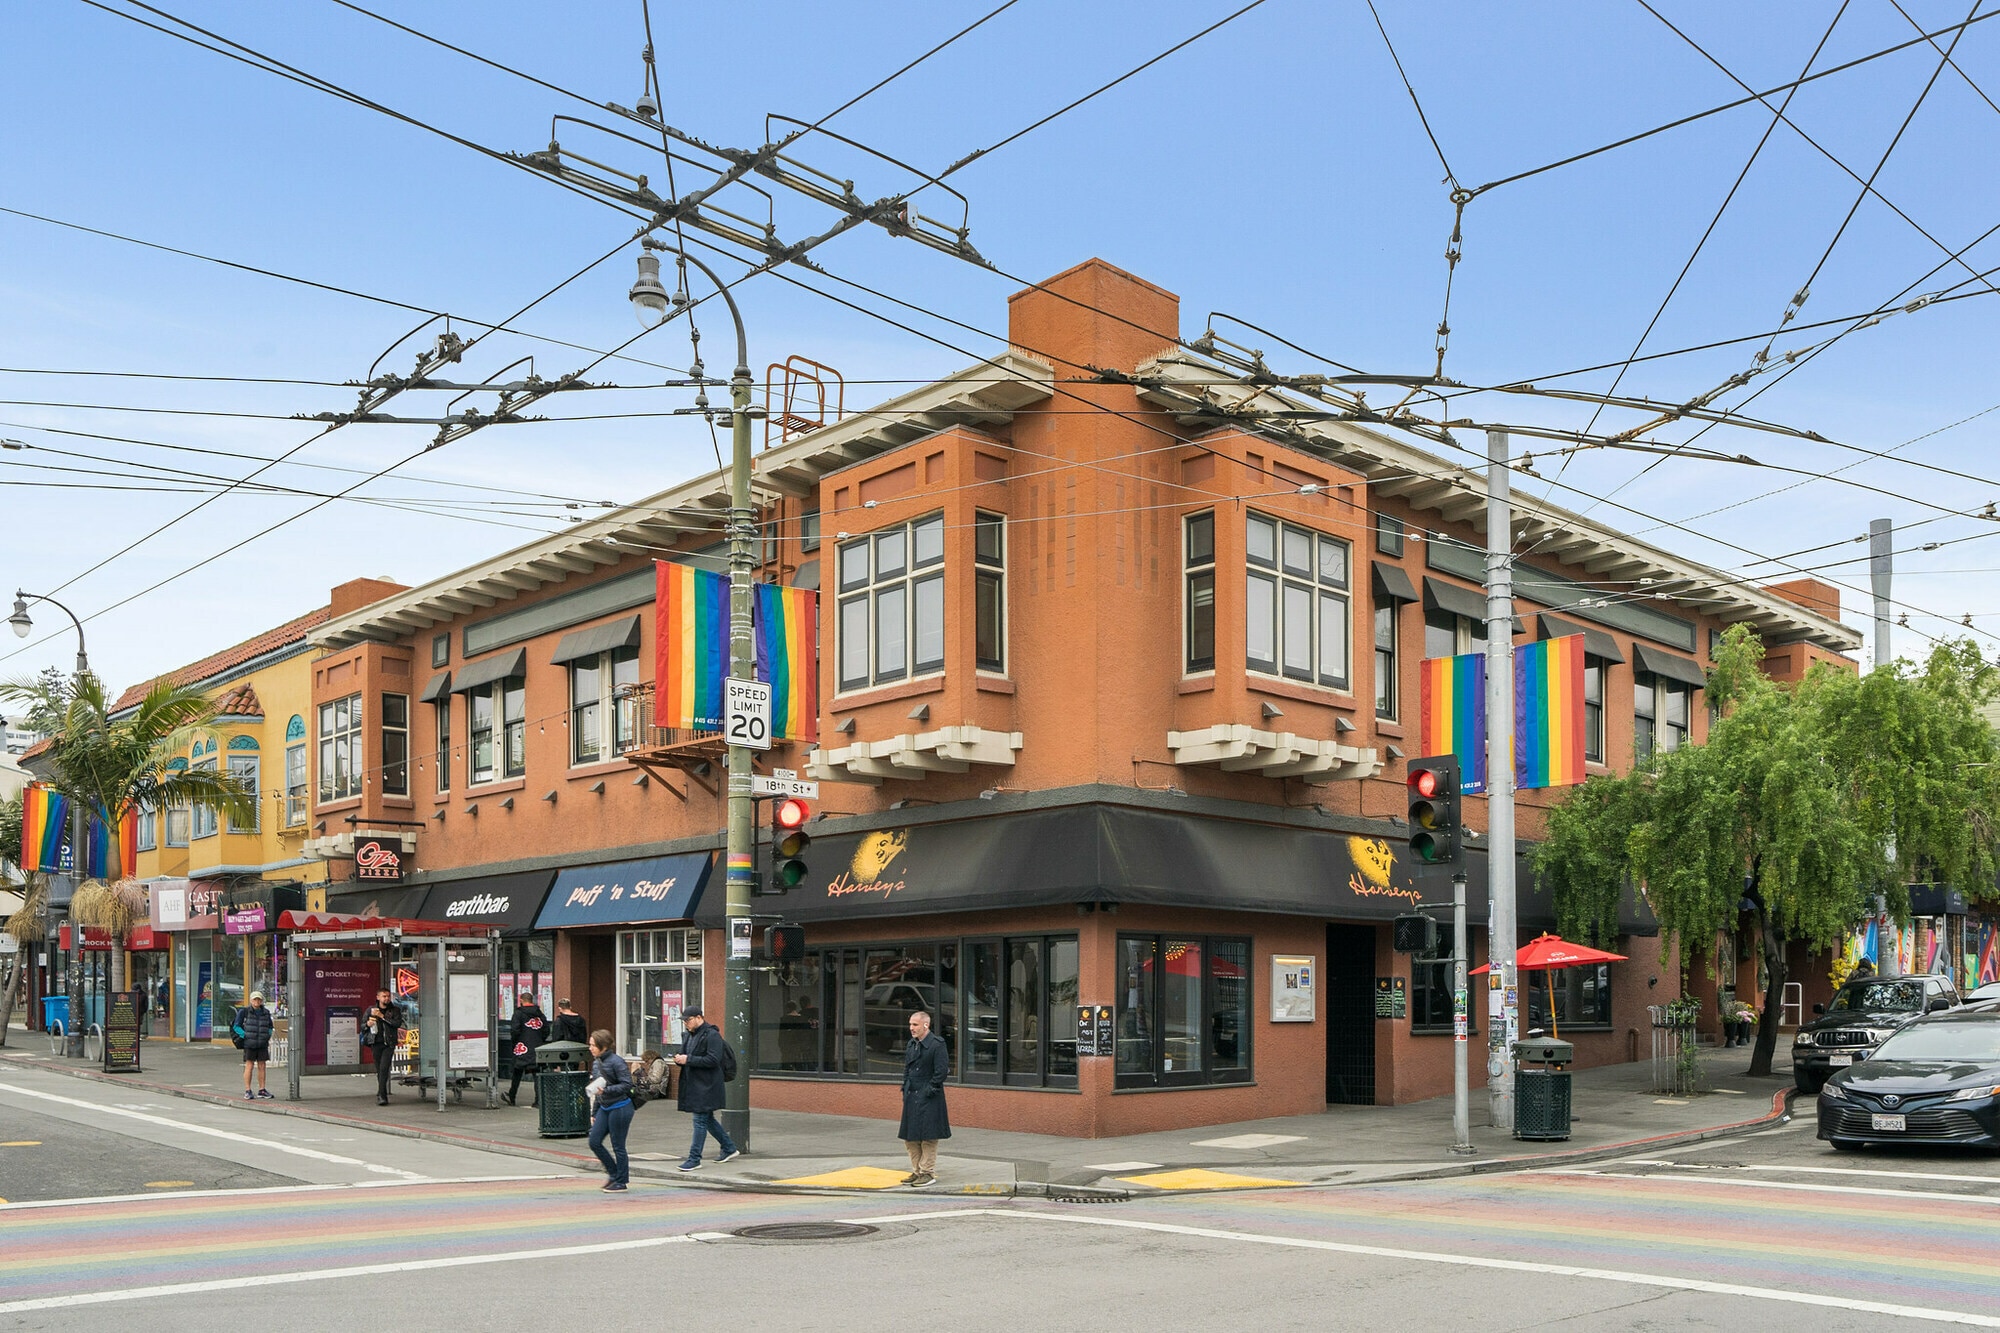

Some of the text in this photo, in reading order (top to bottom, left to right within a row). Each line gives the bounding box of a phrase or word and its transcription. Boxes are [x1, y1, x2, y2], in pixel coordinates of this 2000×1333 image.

[729, 686, 767, 701] SPEED
[733, 700, 763, 714] LIMIT
[731, 714, 765, 740] 20
[776, 769, 790, 777] 4100
[765, 780, 804, 794] 18th St
[356, 841, 392, 869] Oz
[359, 868, 399, 876] PIZZA
[629, 877, 677, 902] Stuff
[827, 868, 906, 899] Harvey's
[1348, 871, 1423, 906] Harvey's
[163, 899, 181, 912] AHF
[351, 971, 370, 979] Money
